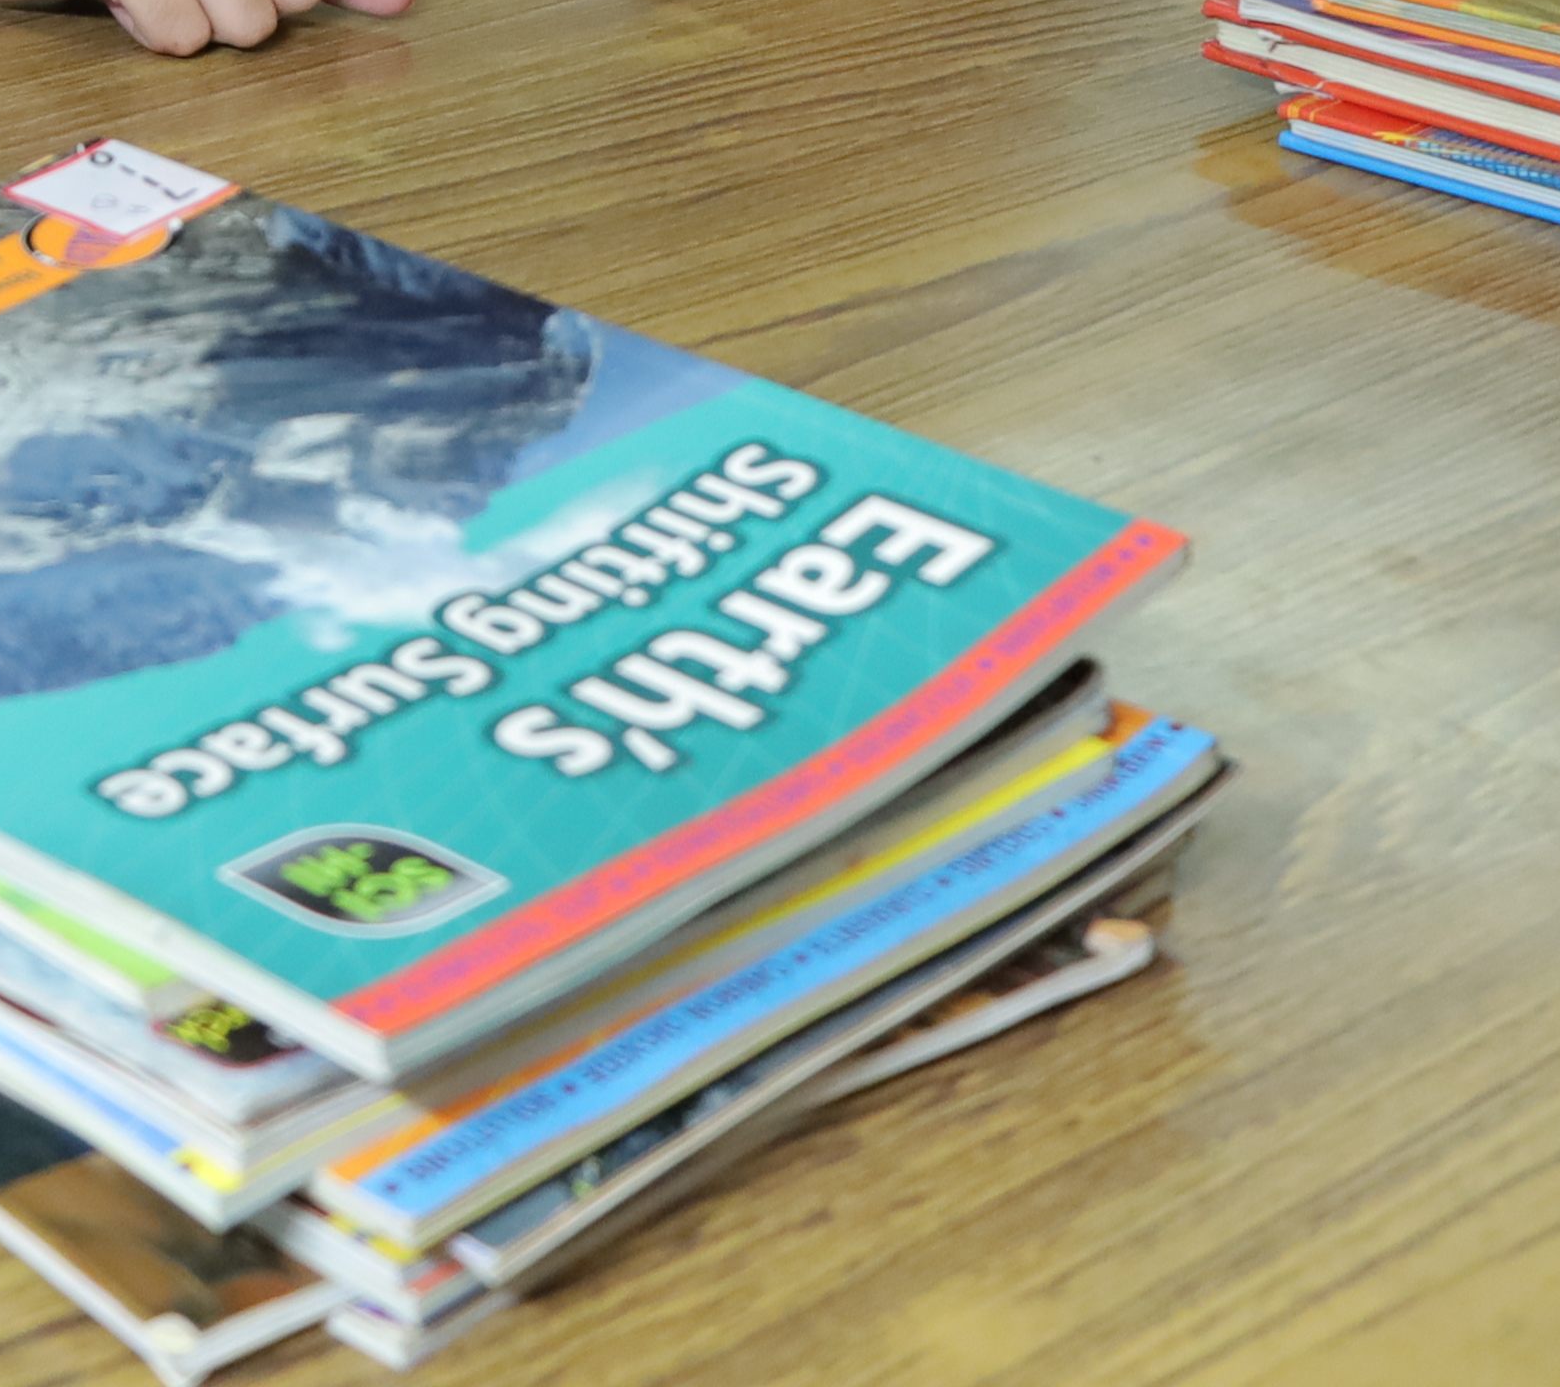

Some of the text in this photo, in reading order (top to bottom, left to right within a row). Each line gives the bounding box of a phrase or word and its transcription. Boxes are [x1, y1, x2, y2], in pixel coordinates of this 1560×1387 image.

[436, 440, 828, 660] Shifting
[491, 491, 998, 783] Earth's
[97, 618, 500, 821] Surface
